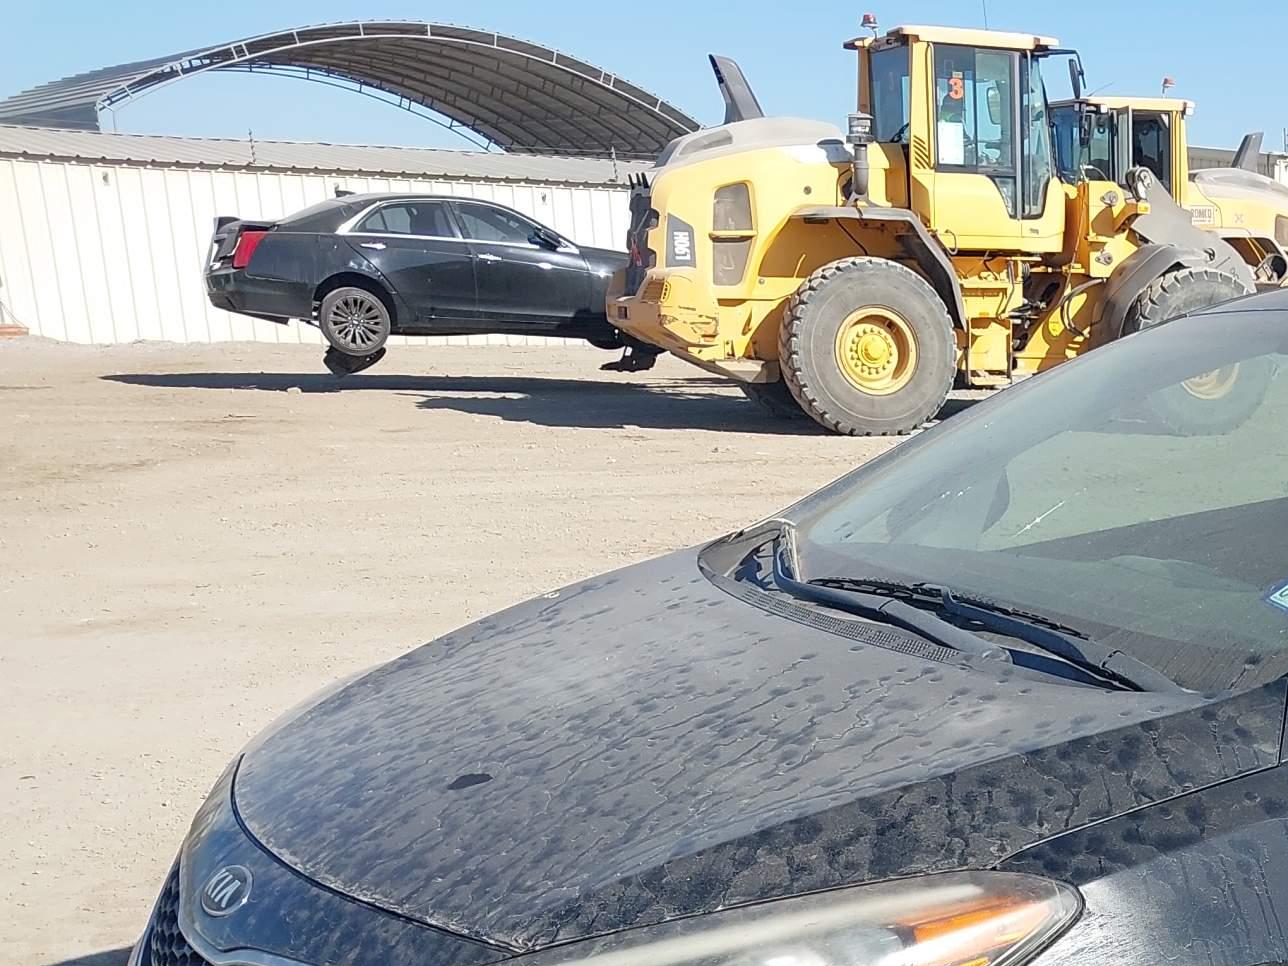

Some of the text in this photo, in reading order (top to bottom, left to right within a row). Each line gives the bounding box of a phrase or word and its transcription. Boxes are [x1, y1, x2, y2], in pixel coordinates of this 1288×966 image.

[949, 78, 964, 99] 3
[673, 231, 691, 260] L90H
[204, 868, 241, 909] KIA
